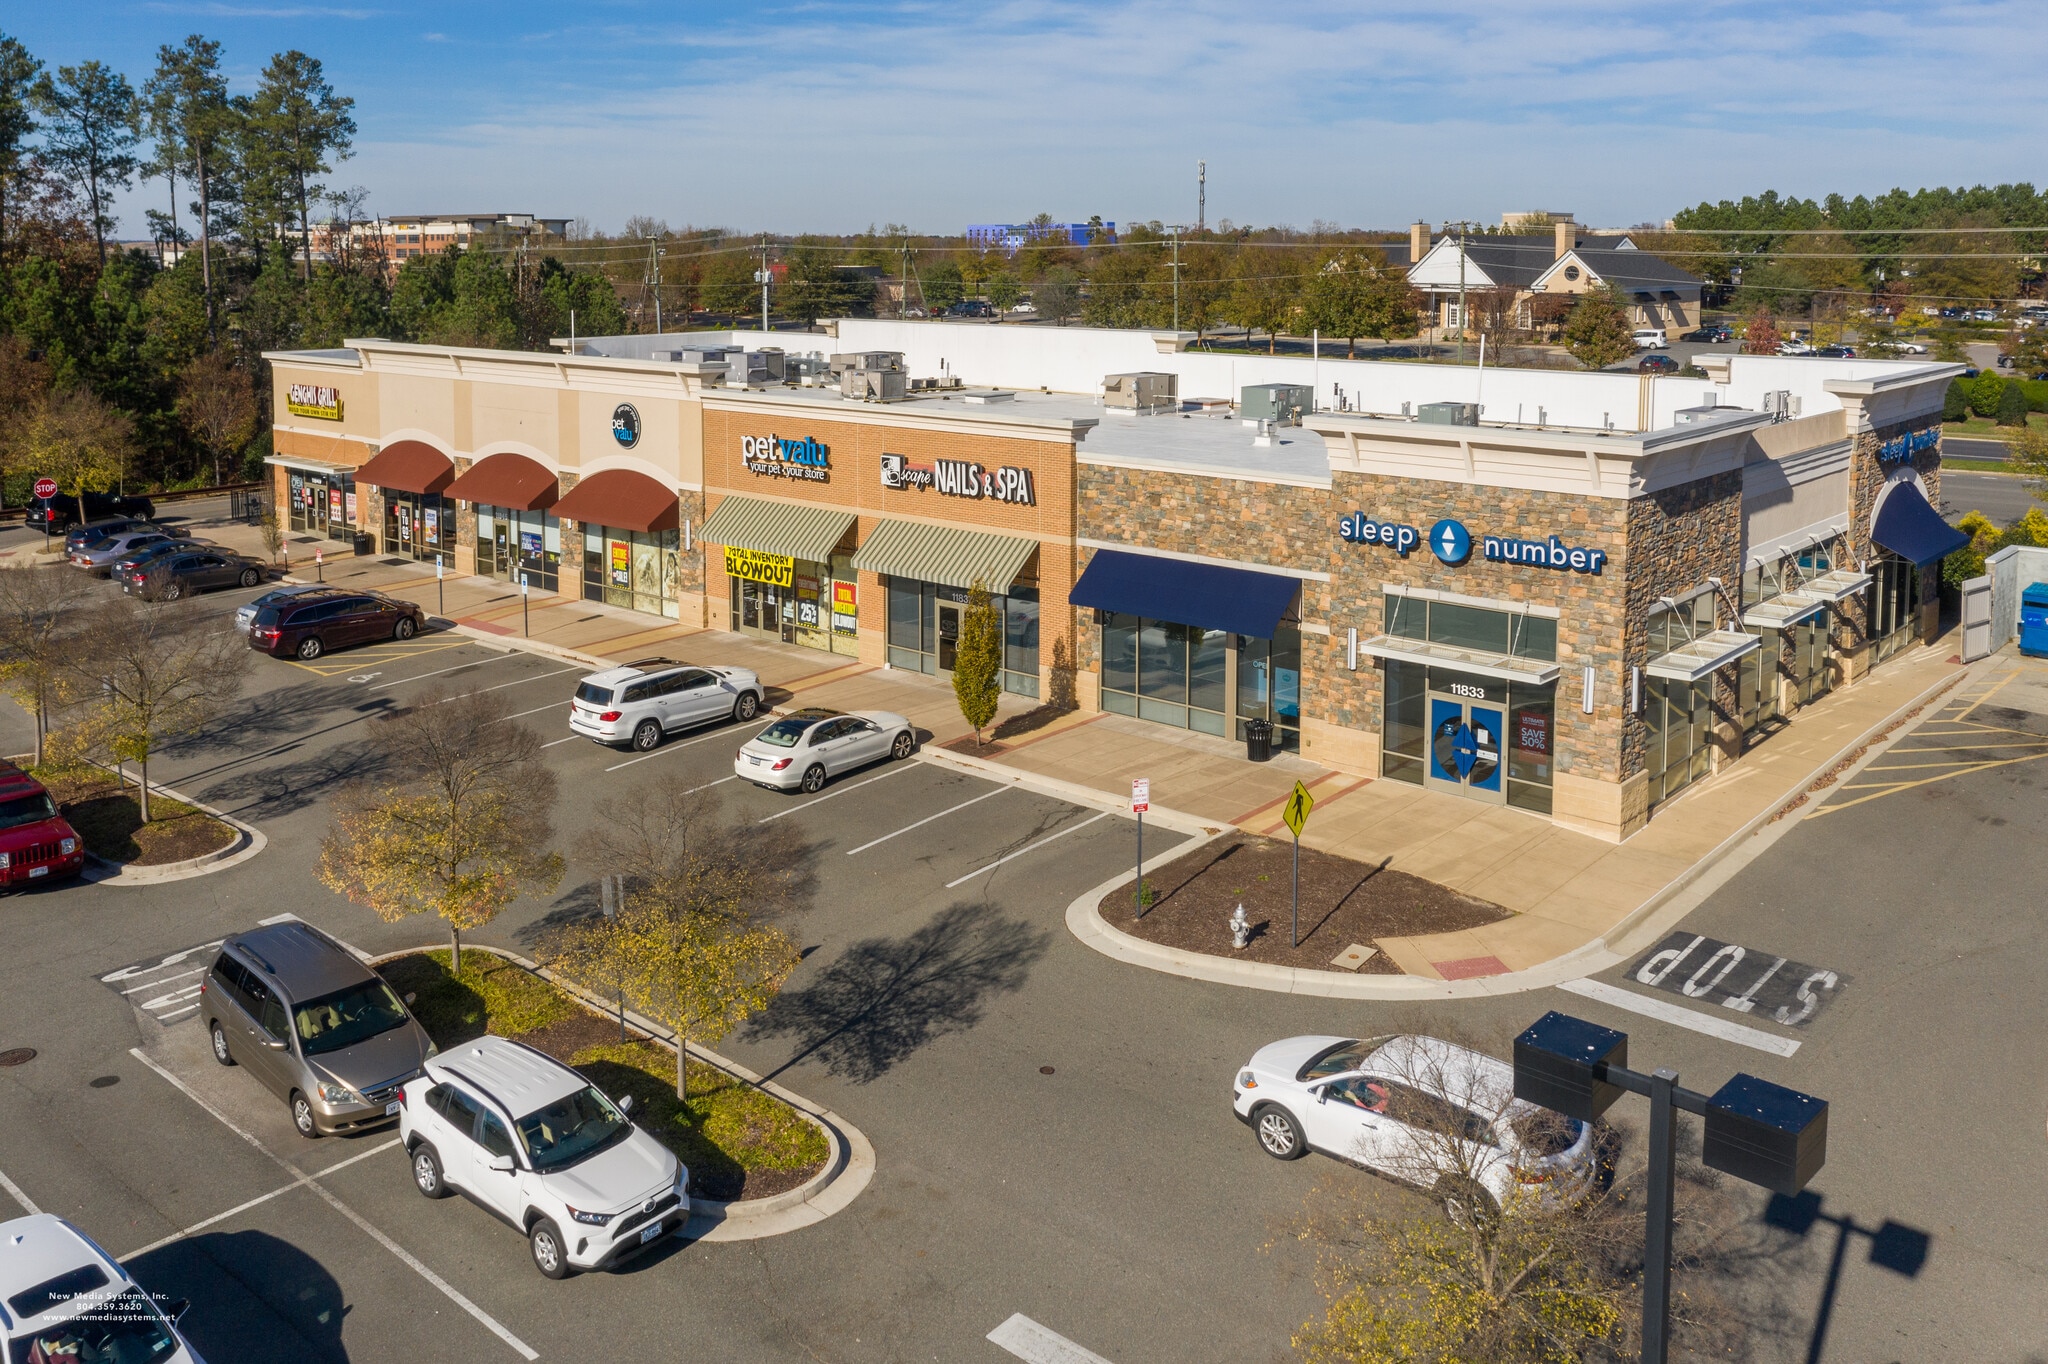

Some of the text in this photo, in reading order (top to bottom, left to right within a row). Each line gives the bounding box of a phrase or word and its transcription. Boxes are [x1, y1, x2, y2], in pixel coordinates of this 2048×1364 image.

[291, 384, 337, 408] GENGHIS GRILL
[611, 418, 625, 432] pet
[614, 428, 633, 441] valu
[741, 434, 828, 467] pet valu
[750, 462, 825, 479] your pet your store
[36, 483, 56, 493] STOP
[934, 461, 979, 497] NAILS
[984, 474, 993, 496] &
[997, 467, 1029, 503] SPA
[1339, 512, 1605, 573] sleep number
[728, 546, 789, 566] TOTAL INVENTORY
[725, 556, 792, 585] BLOWOUT
[837, 588, 853, 602] TOTAL
[952, 593, 970, 604] 1183
[800, 602, 817, 622] 25%
[1252, 660, 1268, 669] OPE
[1450, 683, 1485, 699] 11833
[1522, 716, 1545, 725] ULTIMATE
[1521, 727, 1546, 740] SAVE
[1521, 737, 1545, 750] 50%
[1636, 935, 1839, 1026] STOP
